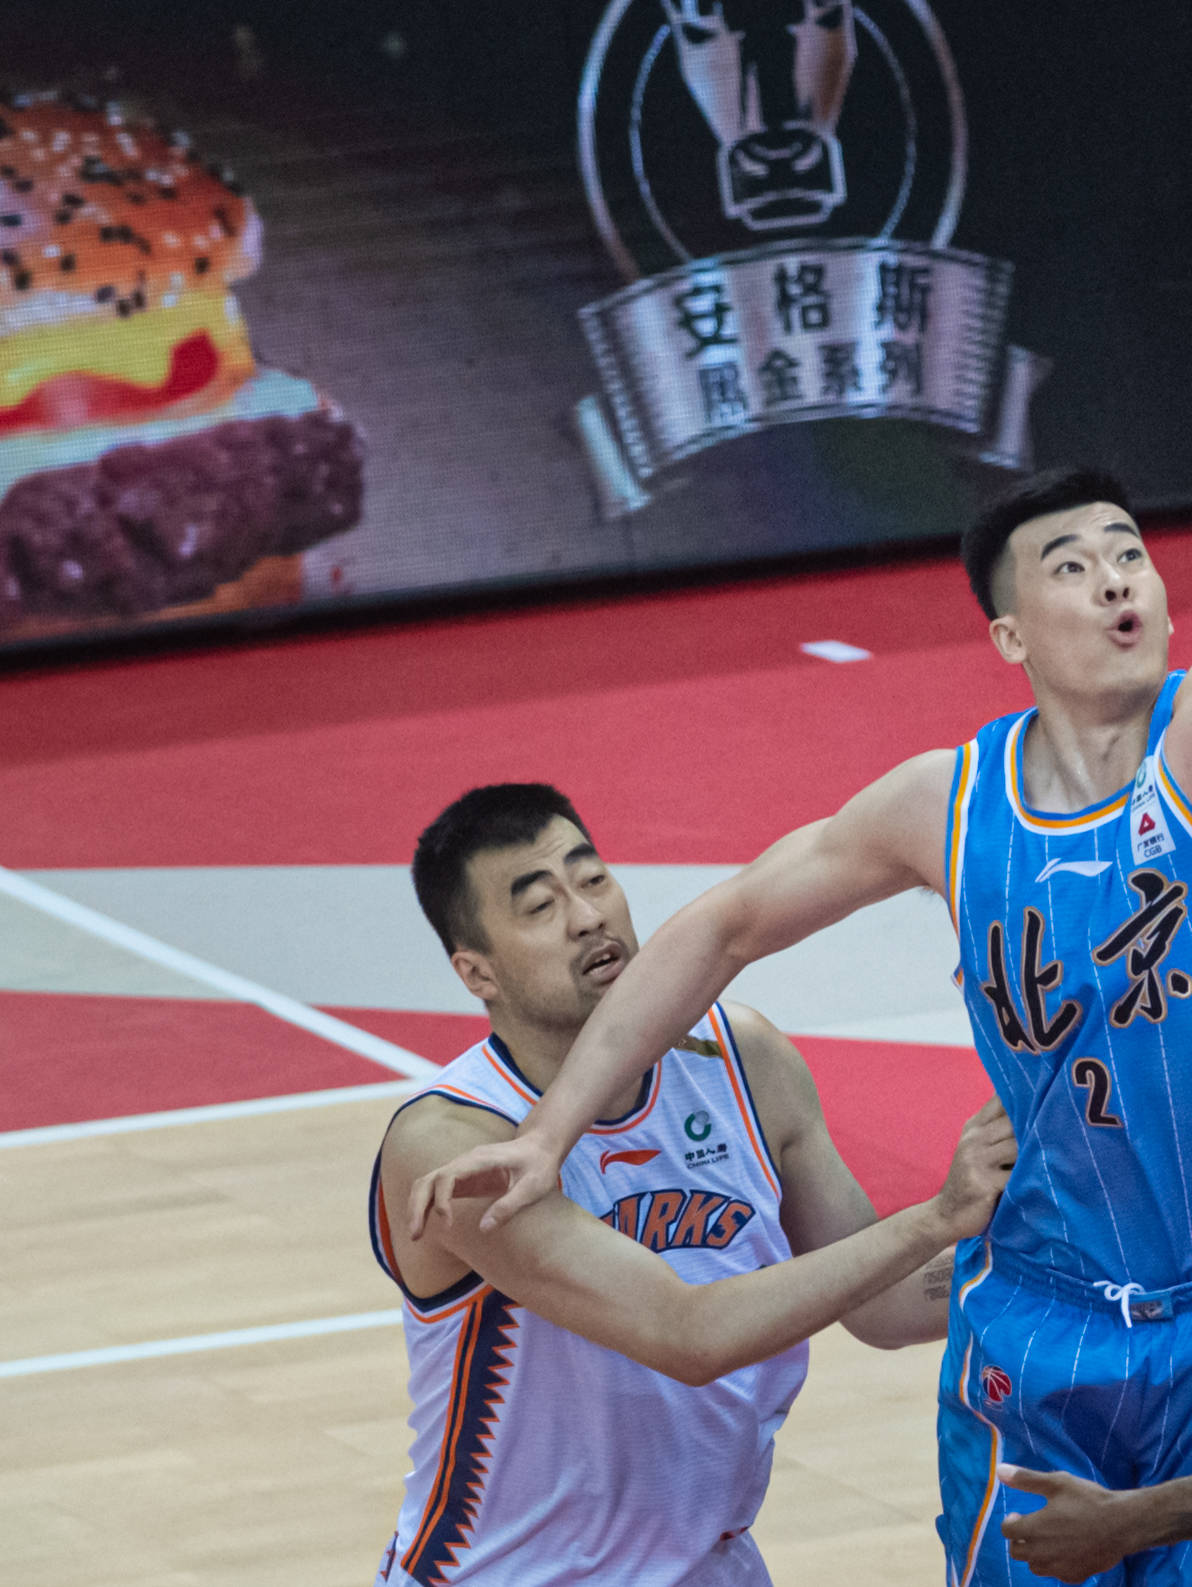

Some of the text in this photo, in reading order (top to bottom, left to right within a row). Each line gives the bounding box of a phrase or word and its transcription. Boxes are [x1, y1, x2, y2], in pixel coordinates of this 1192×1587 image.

[672, 260, 932, 361] 安格斯
[1072, 1057, 1124, 1127] 2
[600, 1188, 756, 1254] ARKS
